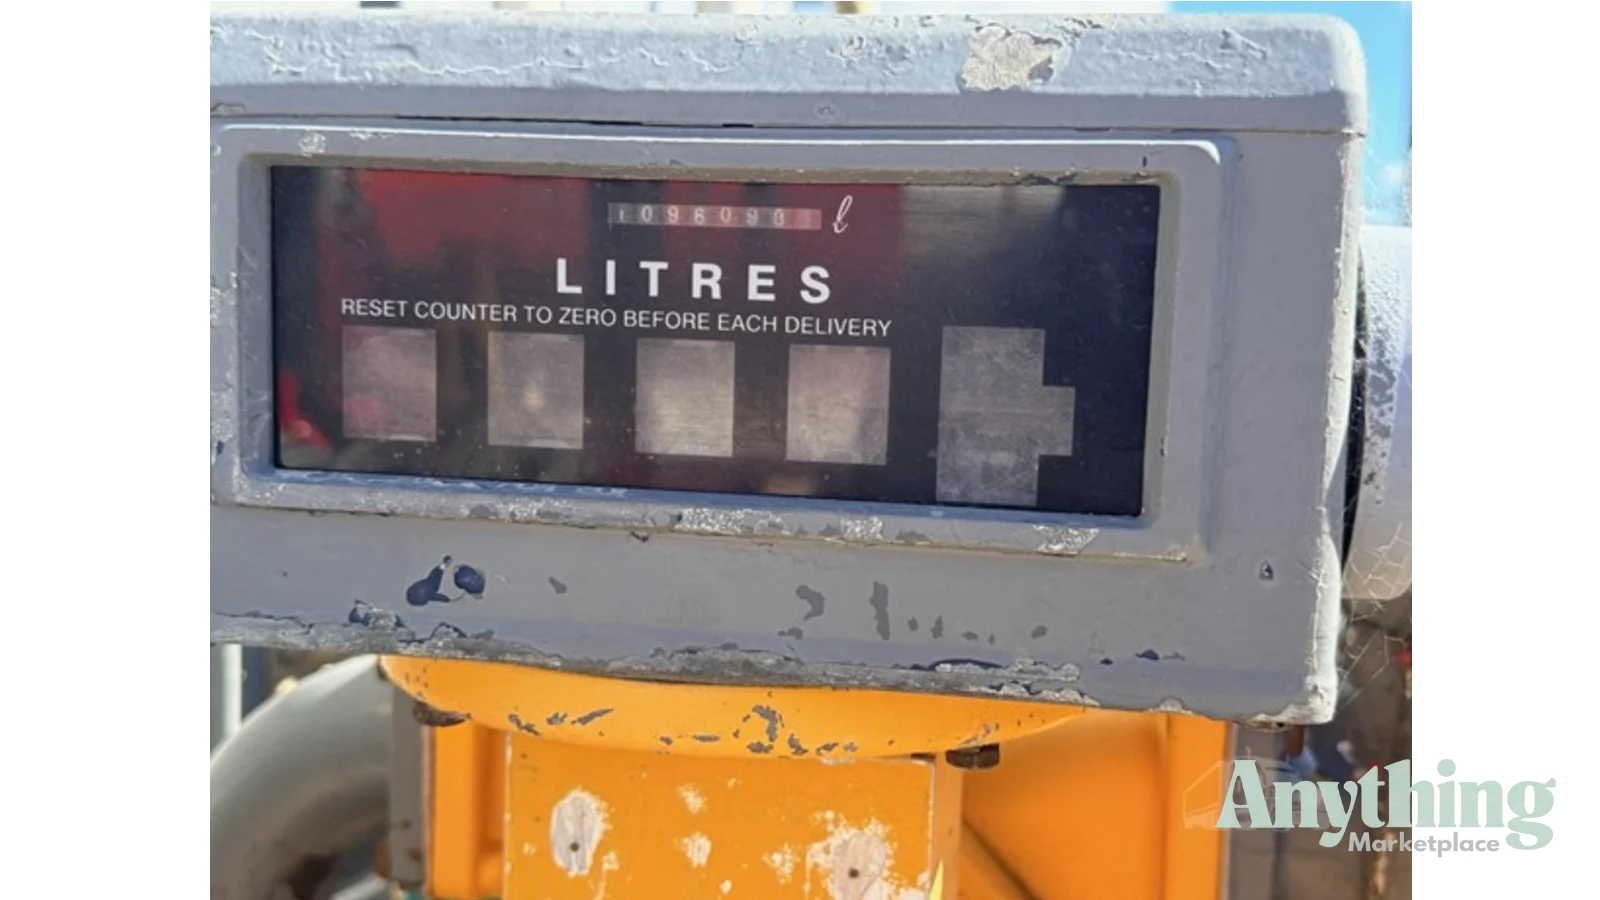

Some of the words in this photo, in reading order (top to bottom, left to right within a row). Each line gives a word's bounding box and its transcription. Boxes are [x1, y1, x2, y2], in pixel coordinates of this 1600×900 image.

[556, 257, 831, 304] LITRES
[341, 298, 408, 318] RESET
[414, 301, 517, 323] COUNTER
[524, 306, 552, 325] TO
[558, 307, 617, 327] ZERO
[624, 311, 710, 331] BEFORE
[717, 314, 778, 333] EACH
[785, 316, 892, 337] DELIVERY
